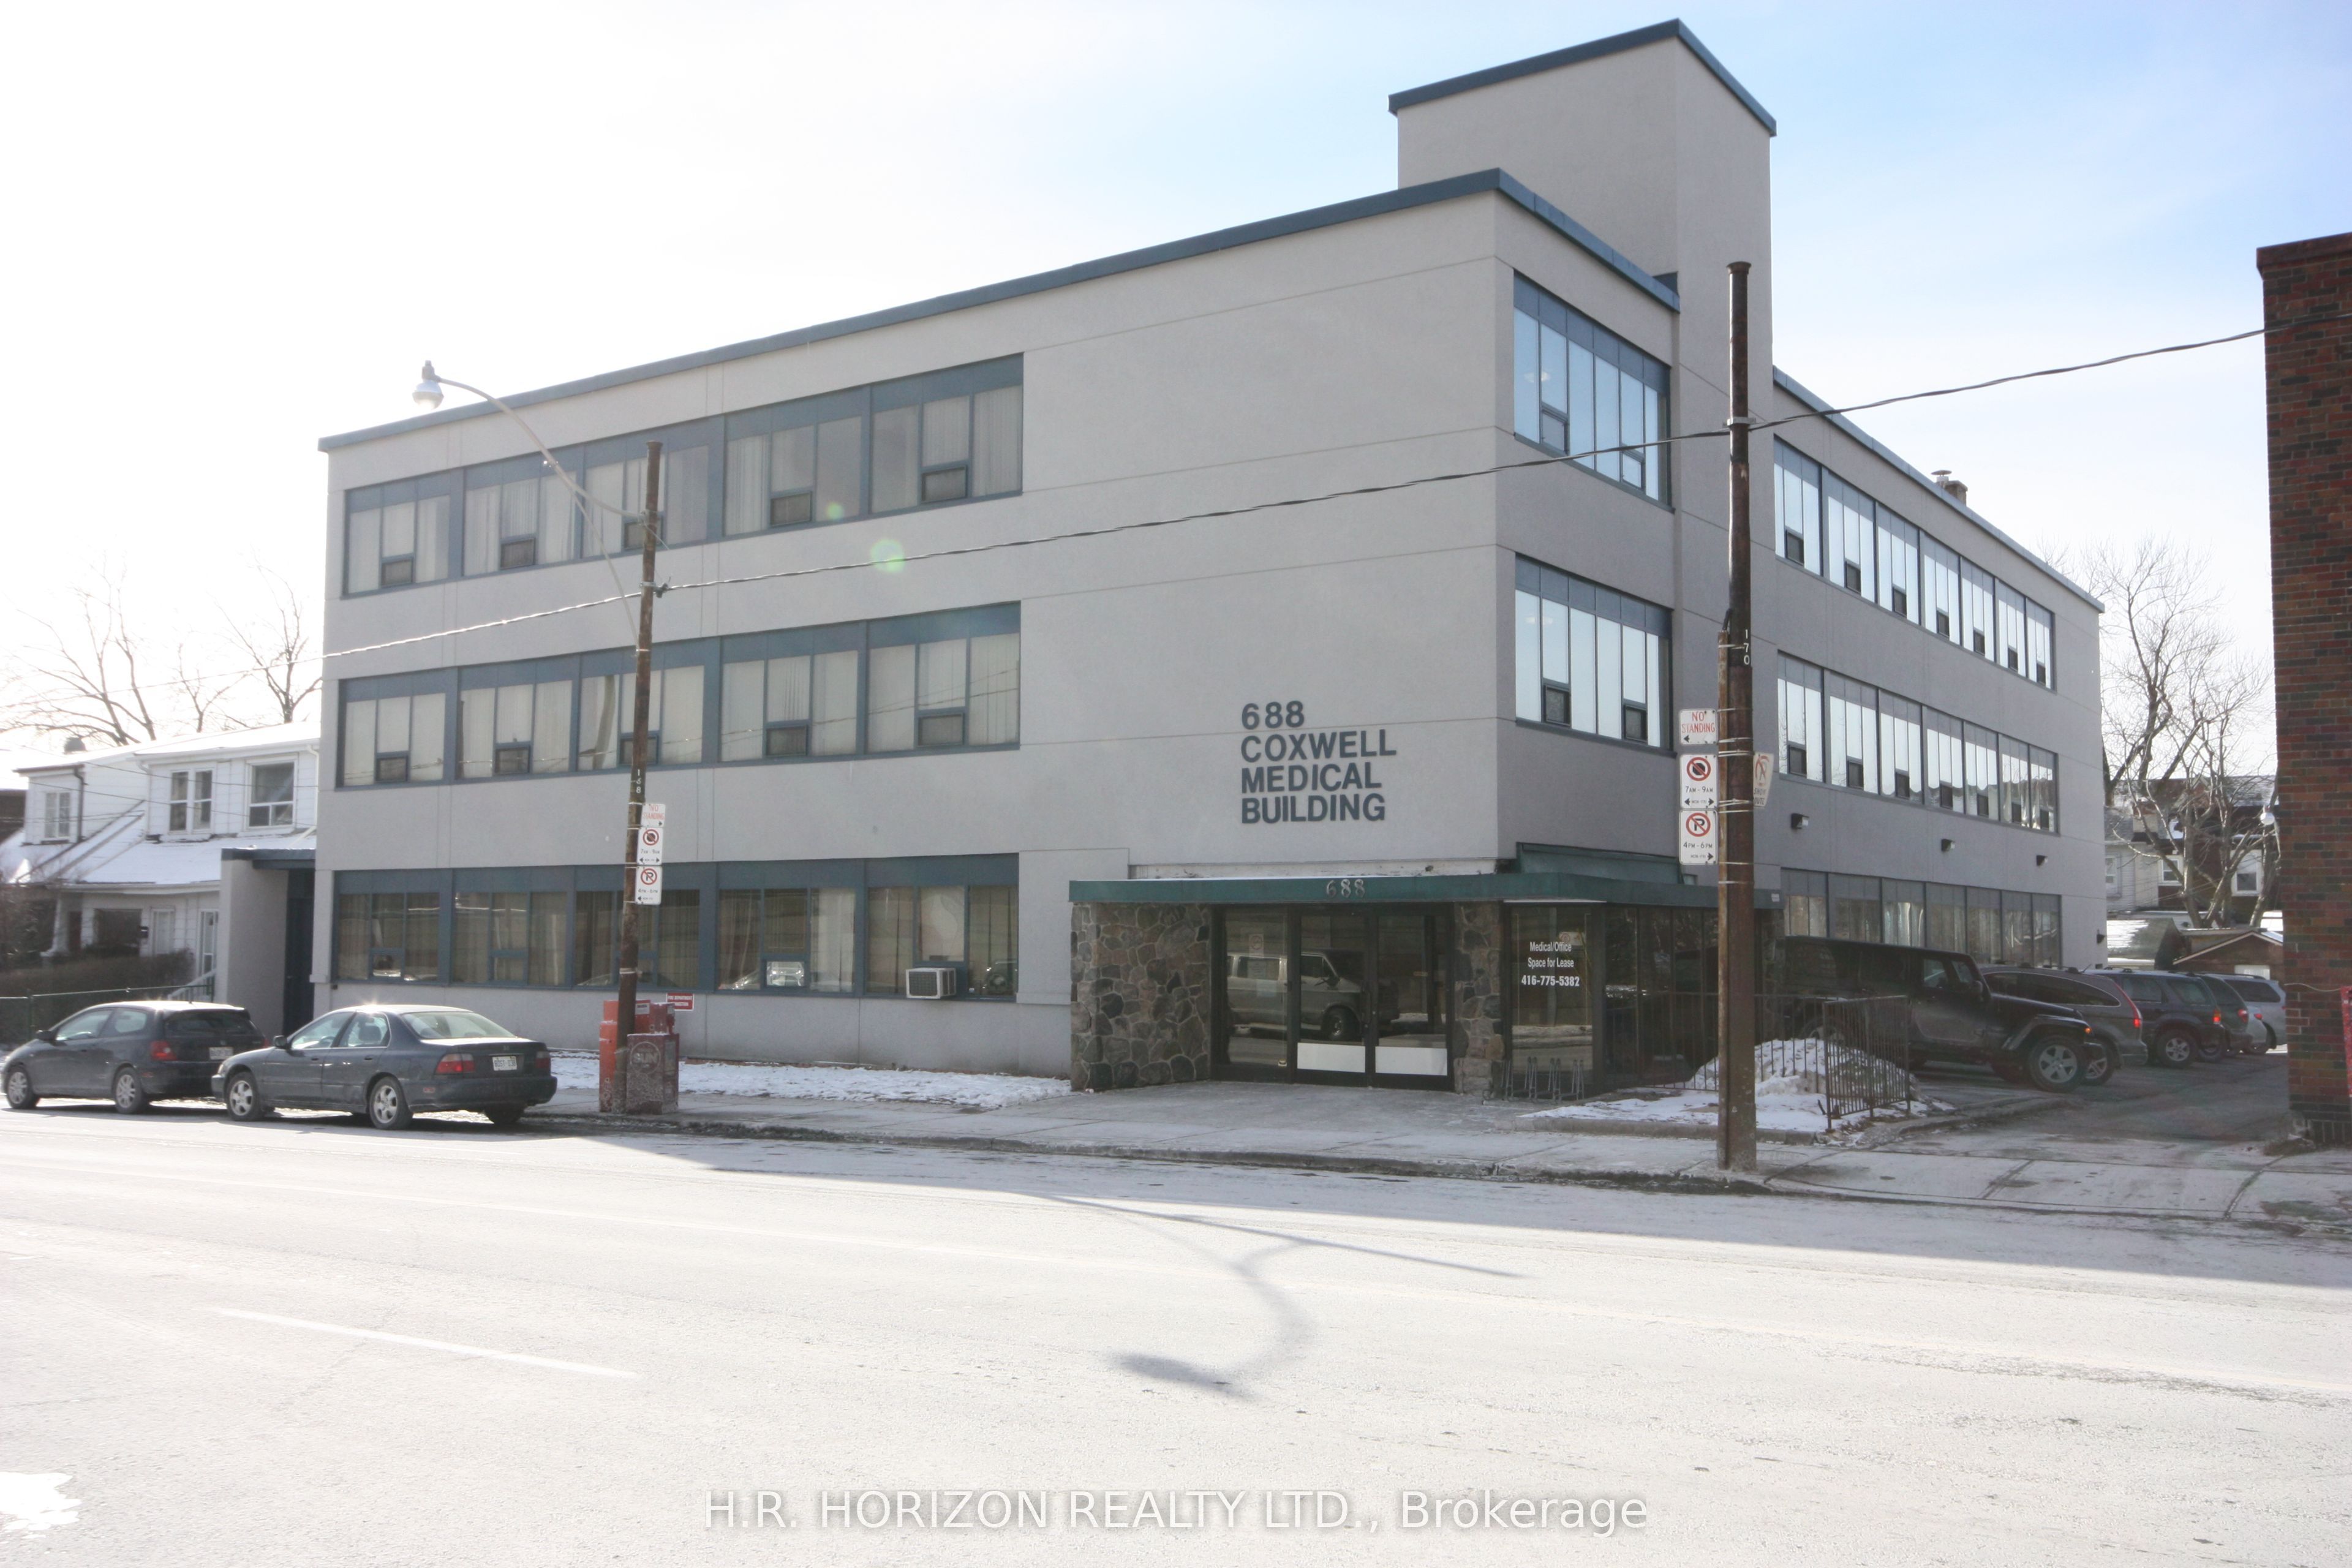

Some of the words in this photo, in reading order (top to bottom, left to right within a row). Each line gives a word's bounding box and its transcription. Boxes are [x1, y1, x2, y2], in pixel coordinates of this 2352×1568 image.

[1241, 700, 1305, 730] 688
[1692, 711, 1705, 721] NO
[1681, 723, 1715, 733] STANDING
[1241, 729, 1396, 763] COXWELL
[1241, 761, 1382, 794] MEDICAL
[1241, 793, 1385, 824] BUILDING
[1326, 879, 1365, 898] 688
[1529, 941, 1572, 952] Medical/Office
[1528, 957, 1547, 970] Space
[1547, 957, 1556, 967] for
[1556, 957, 1574, 968] Lease
[1521, 974, 1580, 987] 416-775-5382
[633, 1053, 658, 1064] SUN
